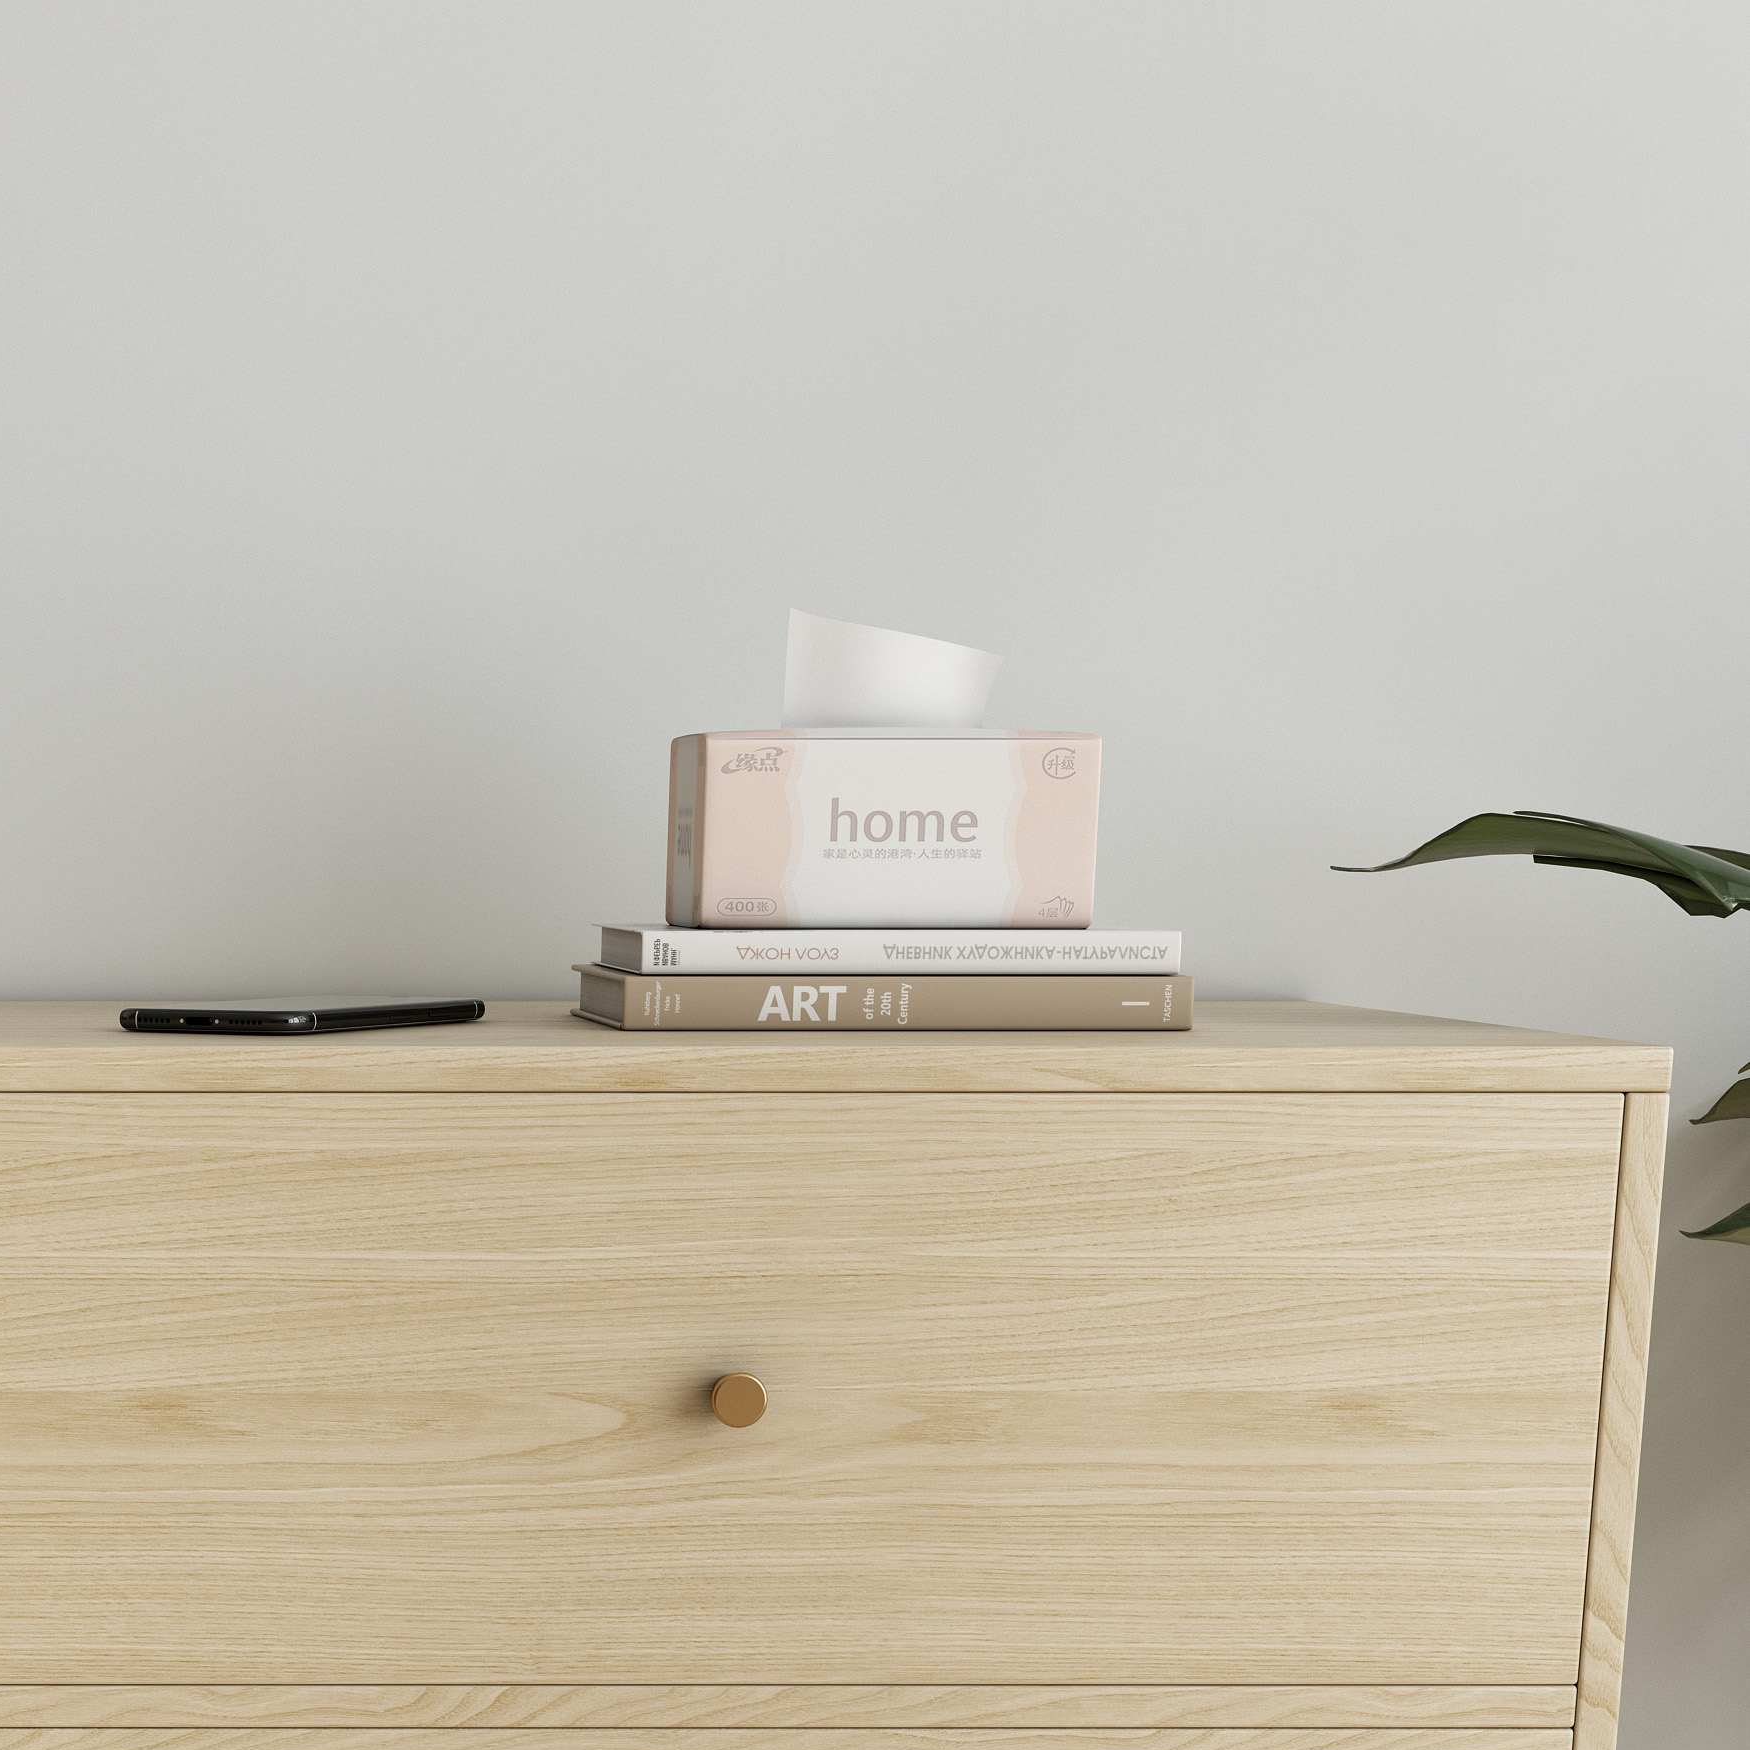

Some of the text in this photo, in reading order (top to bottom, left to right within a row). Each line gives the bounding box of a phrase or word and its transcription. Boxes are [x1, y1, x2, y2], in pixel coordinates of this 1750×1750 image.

[829, 797, 979, 842] home
[757, 985, 848, 1022] ART
[863, 987, 874, 1020] of the
[881, 991, 892, 1016] 20th
[897, 983, 913, 1025] Century
